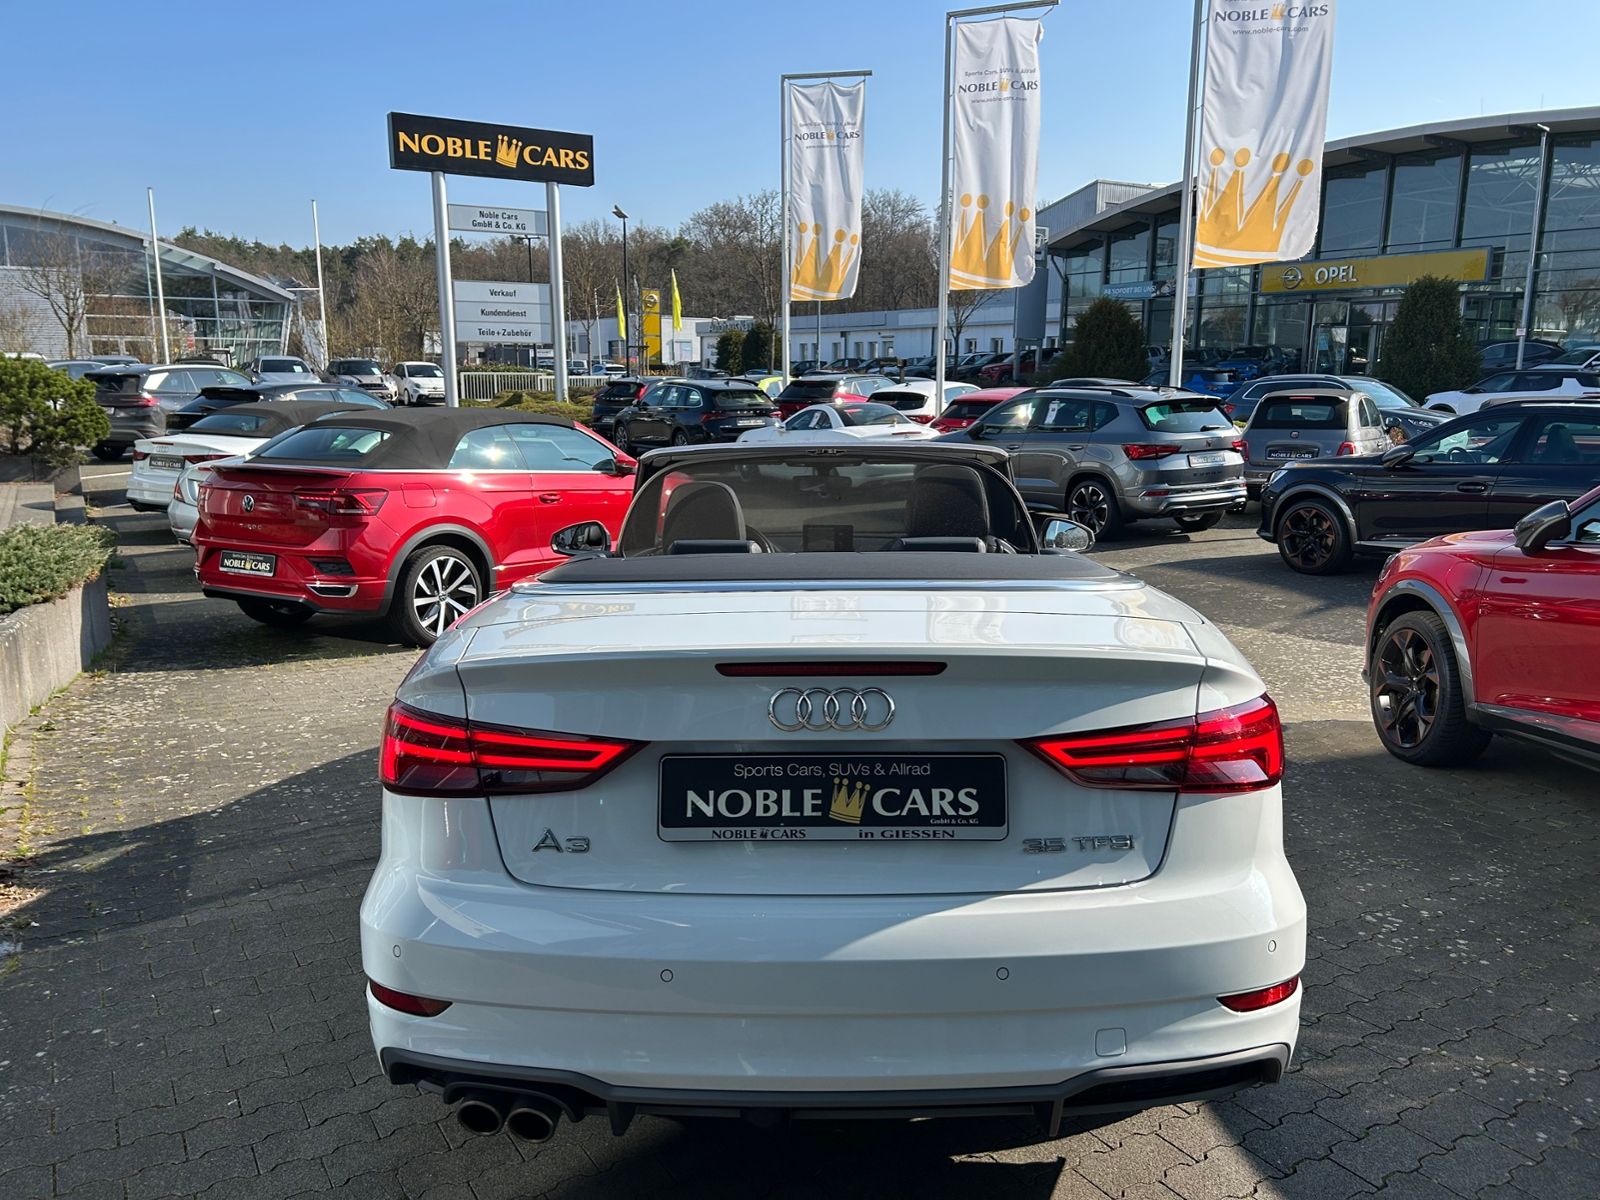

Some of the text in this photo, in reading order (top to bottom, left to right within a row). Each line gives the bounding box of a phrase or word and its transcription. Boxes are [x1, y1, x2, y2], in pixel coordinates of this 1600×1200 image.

[1215, 4, 1329, 23] NOBLE CARS
[959, 80, 1039, 94] NOBLE CARS
[795, 130, 860, 141] NOBLE CARS
[398, 131, 590, 170] NOBLE CARS
[479, 210, 519, 221] Noble Cars
[472, 219, 527, 231] GmbH & Co. KG
[1315, 264, 1358, 286] OPEL
[489, 288, 517, 298] Verkauf
[480, 308, 527, 318] Kundendienst
[502, 328, 532, 338] Zubehör
[223, 558, 271, 571] NOBLE CARS
[734, 763, 931, 779] Sports Cars, SUVs & Allrad
[686, 787, 979, 818] NOBLE CARS
[531, 827, 591, 854] A3
[711, 828, 806, 840] NOBLE CARS
[858, 829, 955, 839] in GIESSEN
[1022, 834, 1135, 854] 35 TFSI
